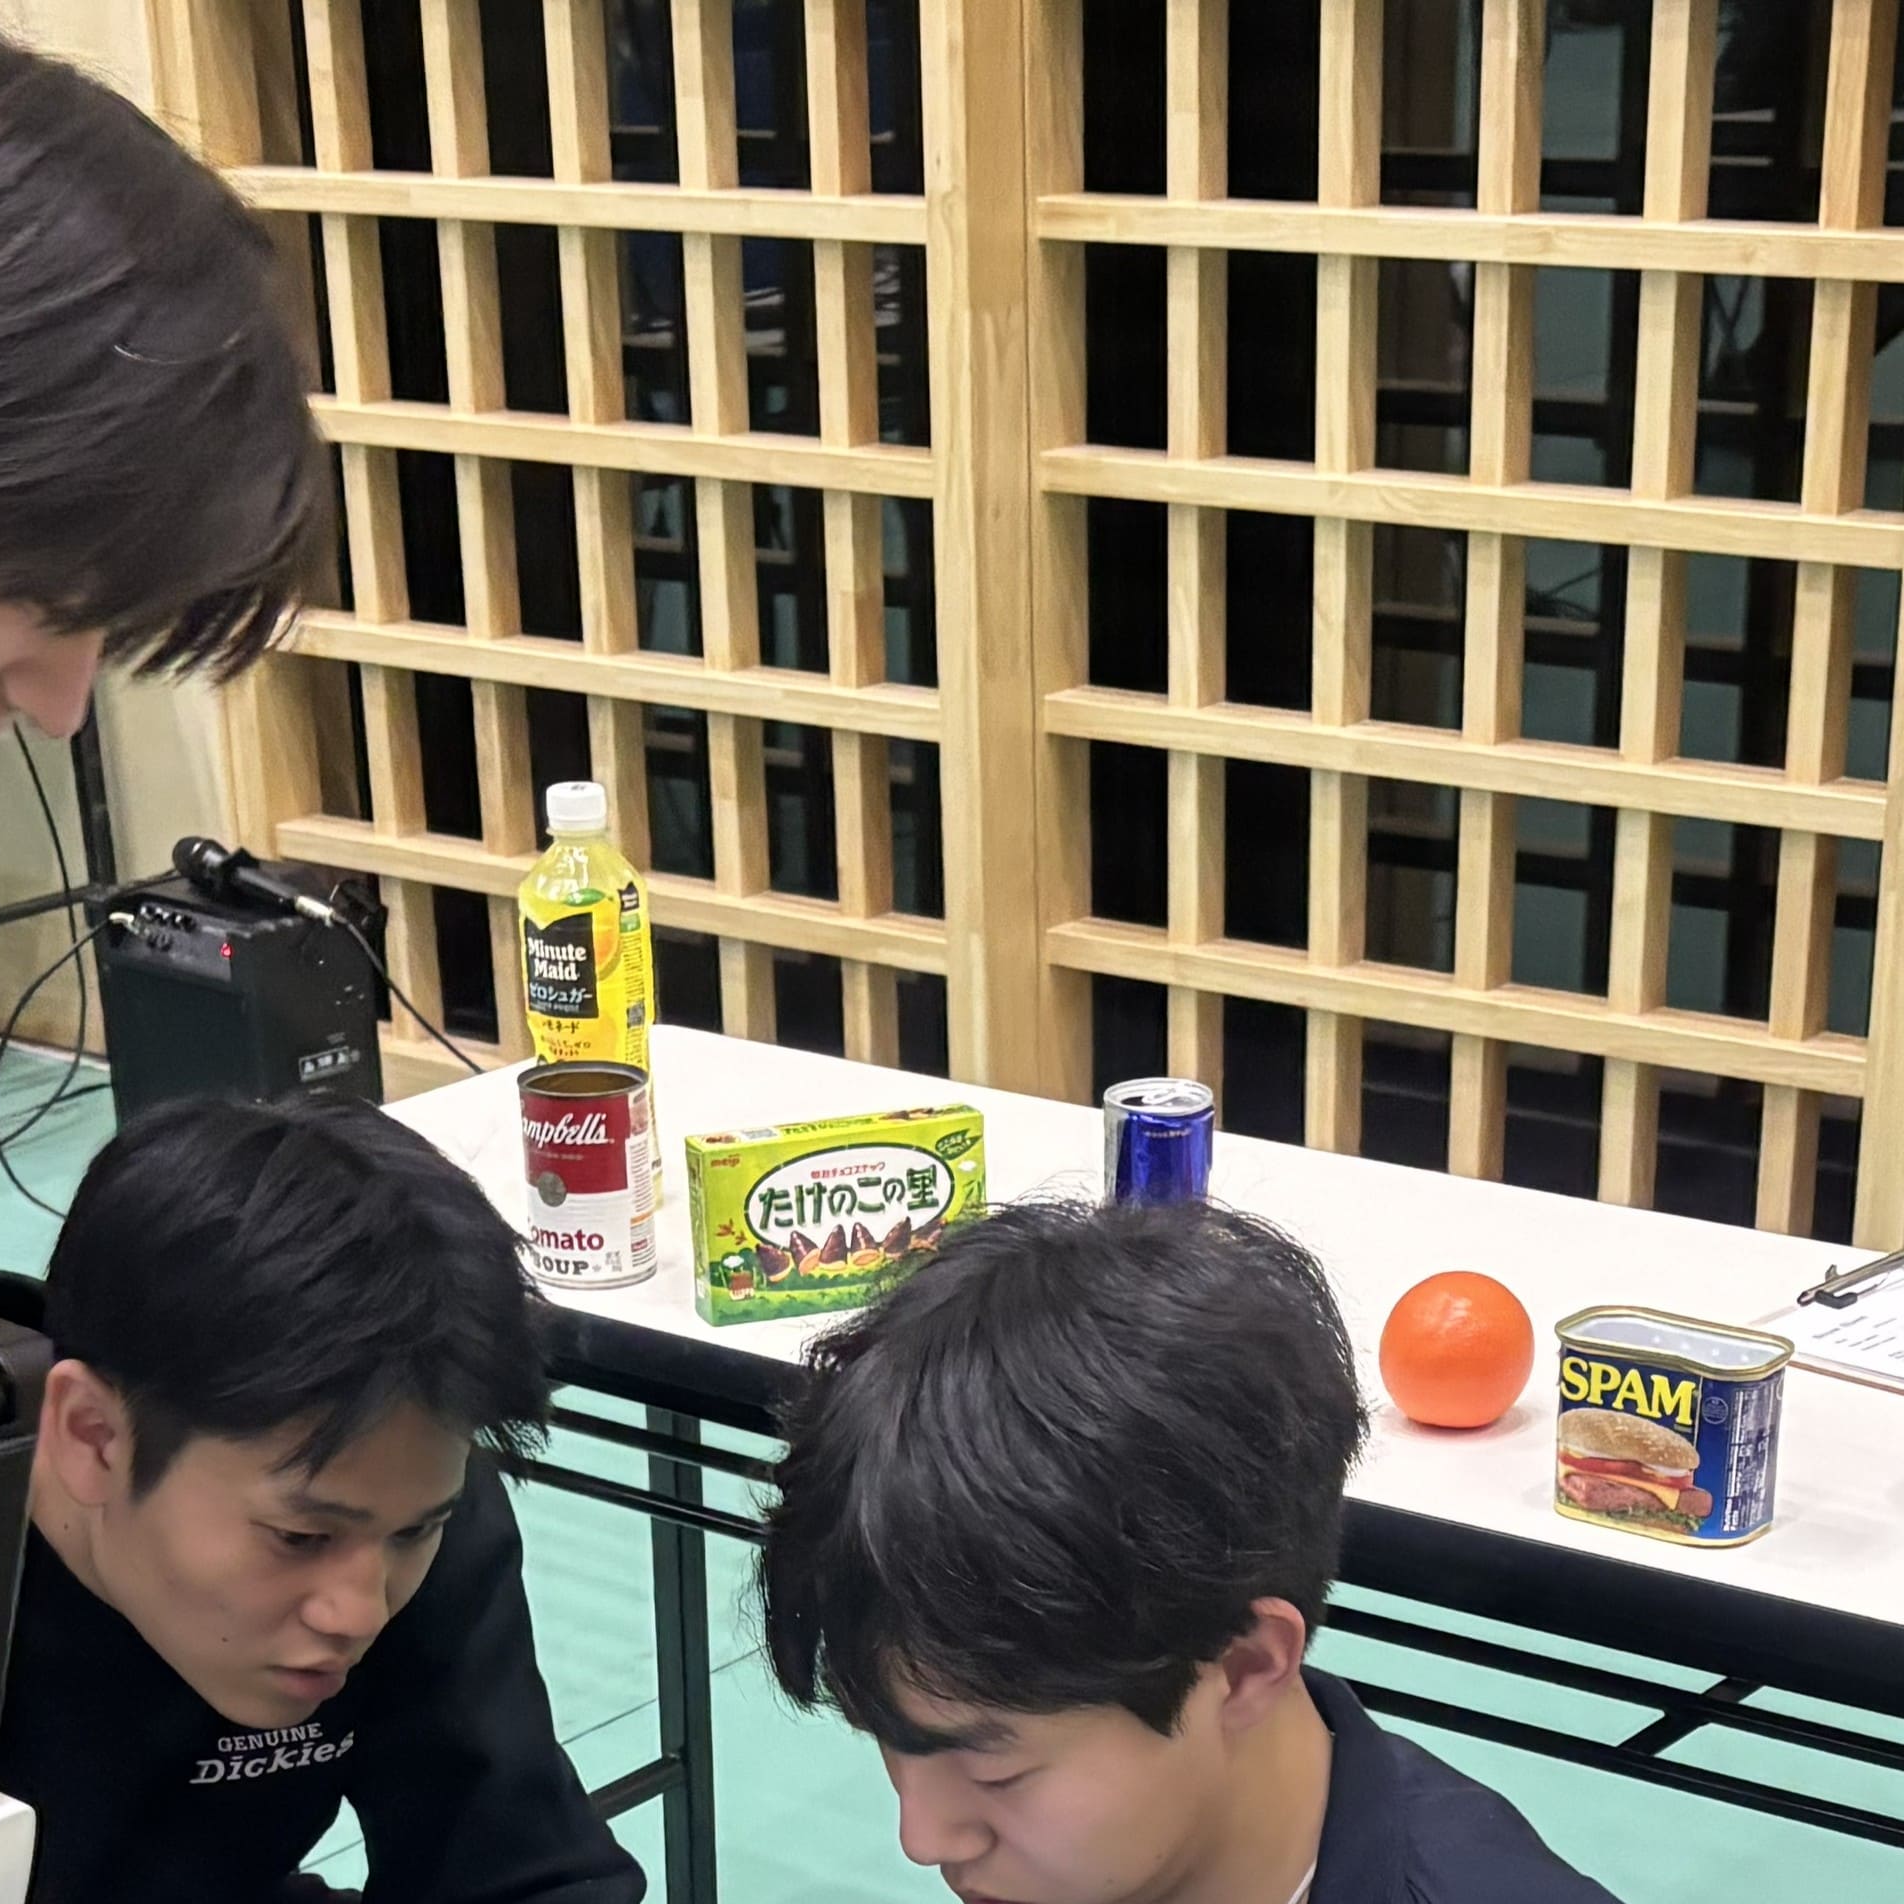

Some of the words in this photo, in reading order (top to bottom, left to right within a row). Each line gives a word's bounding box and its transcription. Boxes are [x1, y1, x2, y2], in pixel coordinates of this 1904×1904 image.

[527, 937, 587, 962] Minute
[534, 958, 578, 981] Maid
[521, 1113, 609, 1149] ampbell's
[710, 1153, 741, 1168] meiji
[758, 1164, 940, 1230] たけのこの里
[527, 1224, 605, 1252] omato
[1560, 1356, 1696, 1427] SPAM
[217, 1722, 324, 1753] GENUINE
[188, 1730, 355, 1785] Dickies
